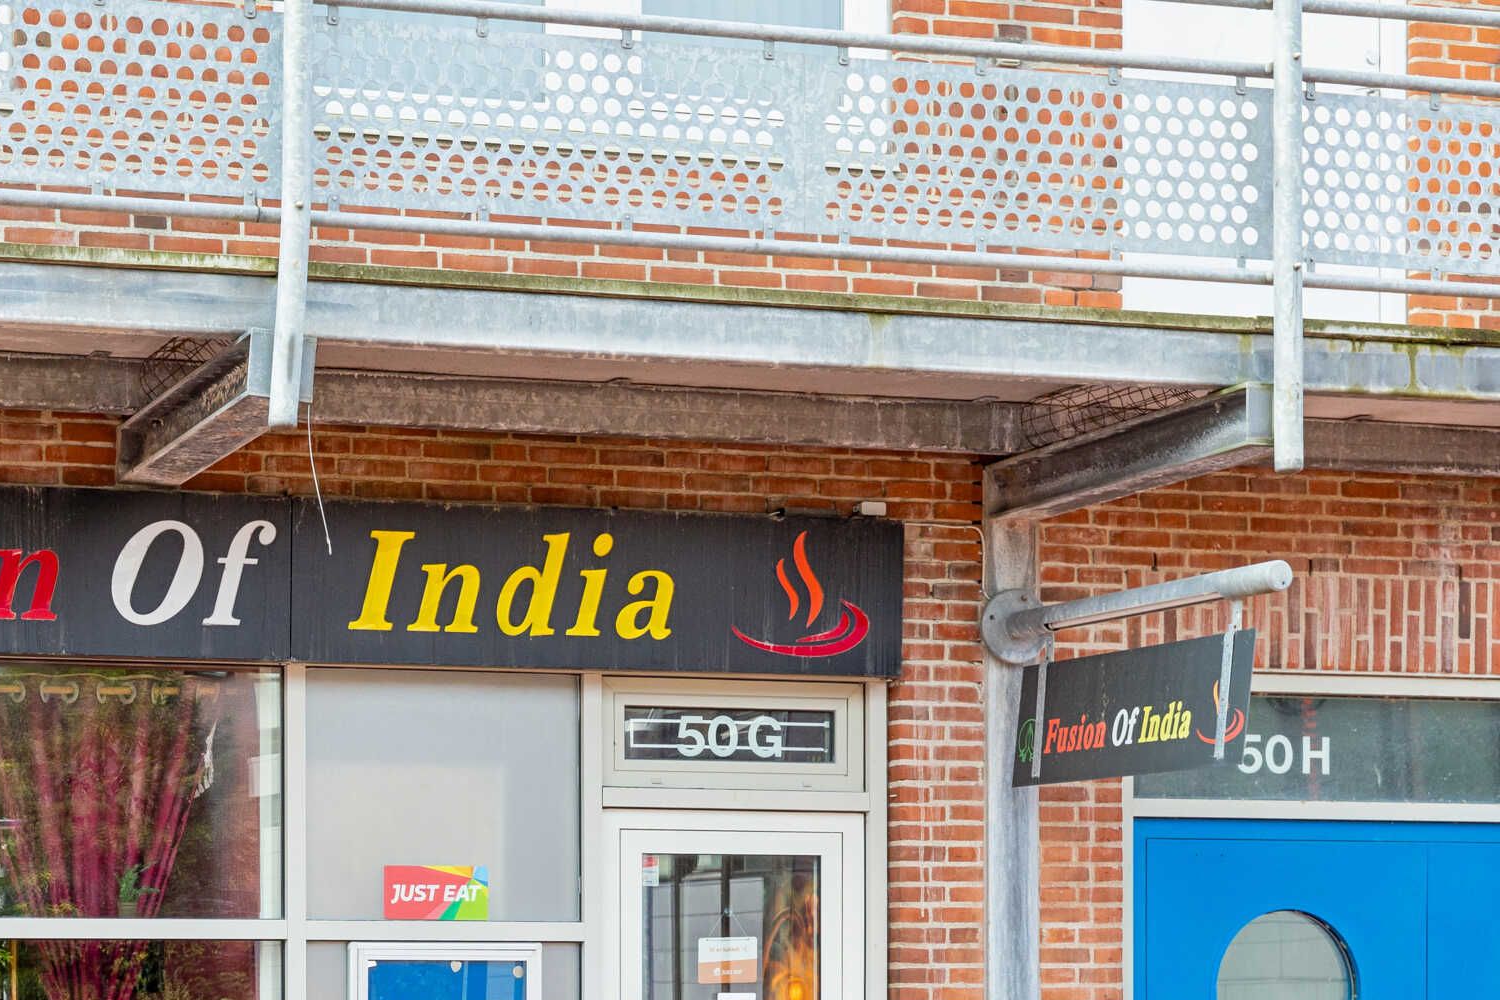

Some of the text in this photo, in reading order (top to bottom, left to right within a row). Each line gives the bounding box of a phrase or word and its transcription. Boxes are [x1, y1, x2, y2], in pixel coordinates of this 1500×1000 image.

[111, 519, 277, 627] Of
[347, 530, 676, 641] India
[1043, 700, 1193, 755] Fusion Of India
[390, 883, 481, 905] JUST EAT
